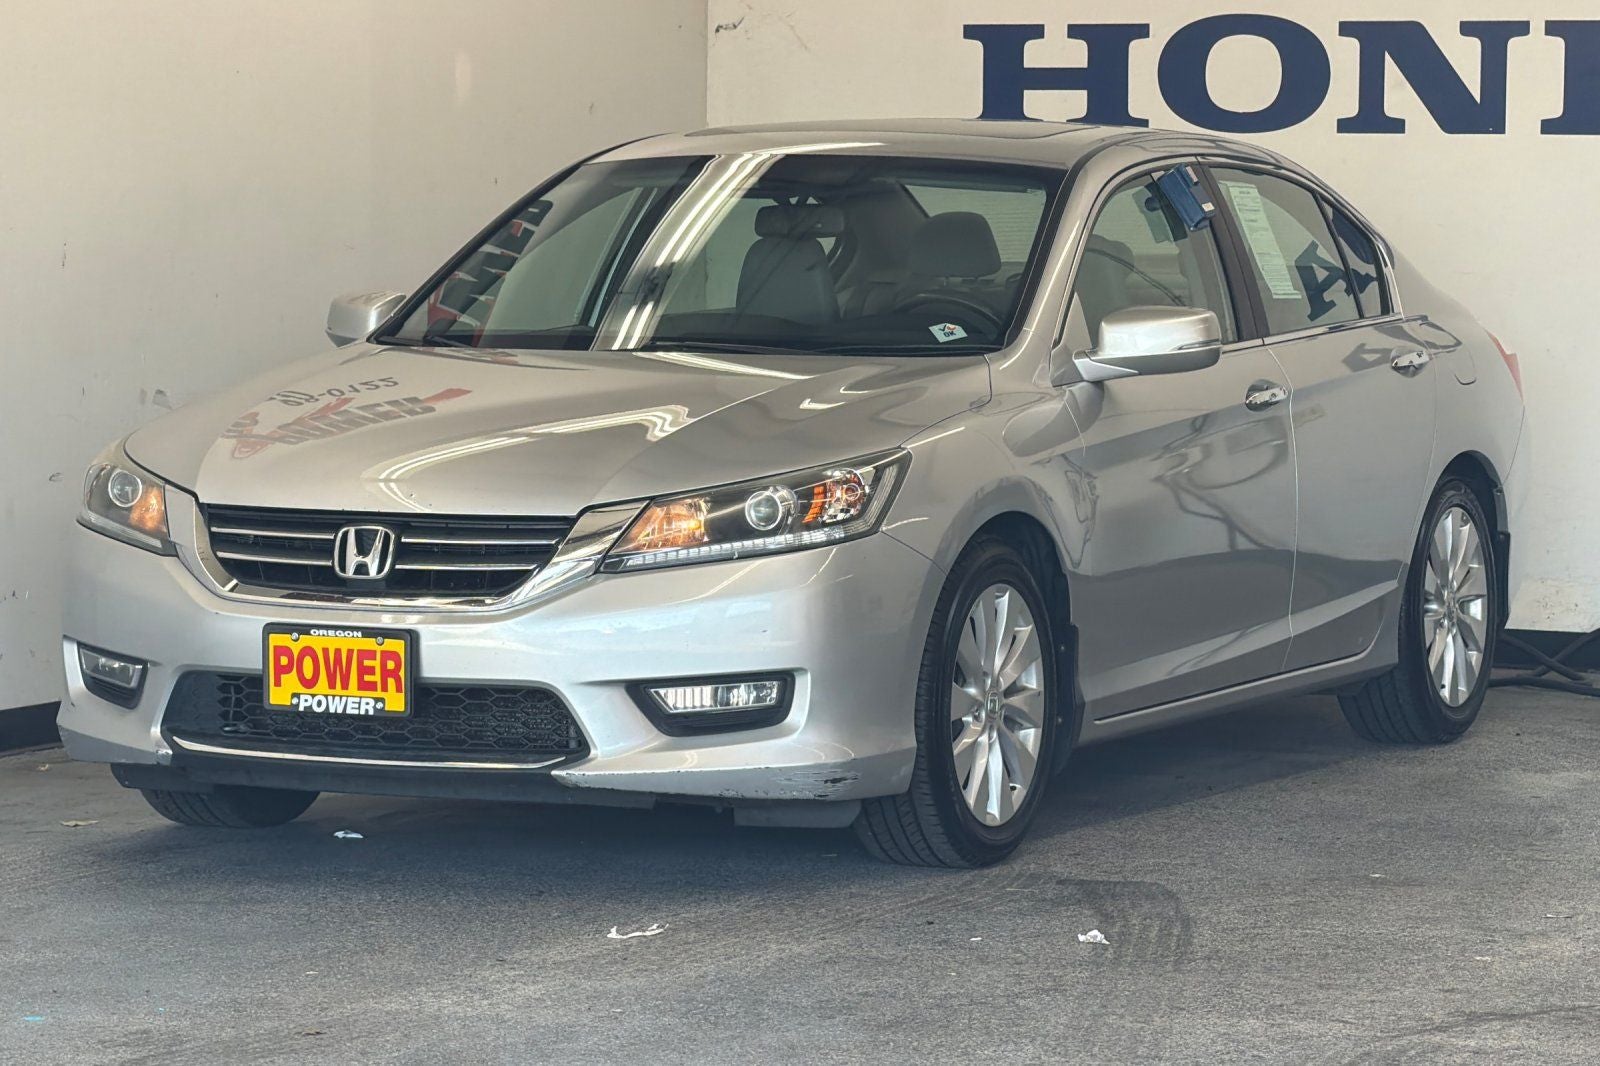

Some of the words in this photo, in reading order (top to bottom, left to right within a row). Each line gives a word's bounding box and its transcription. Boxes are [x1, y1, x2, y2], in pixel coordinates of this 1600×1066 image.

[310, 629, 362, 638] OREGON
[273, 645, 404, 693] POWER
[298, 694, 375, 715] POWER
